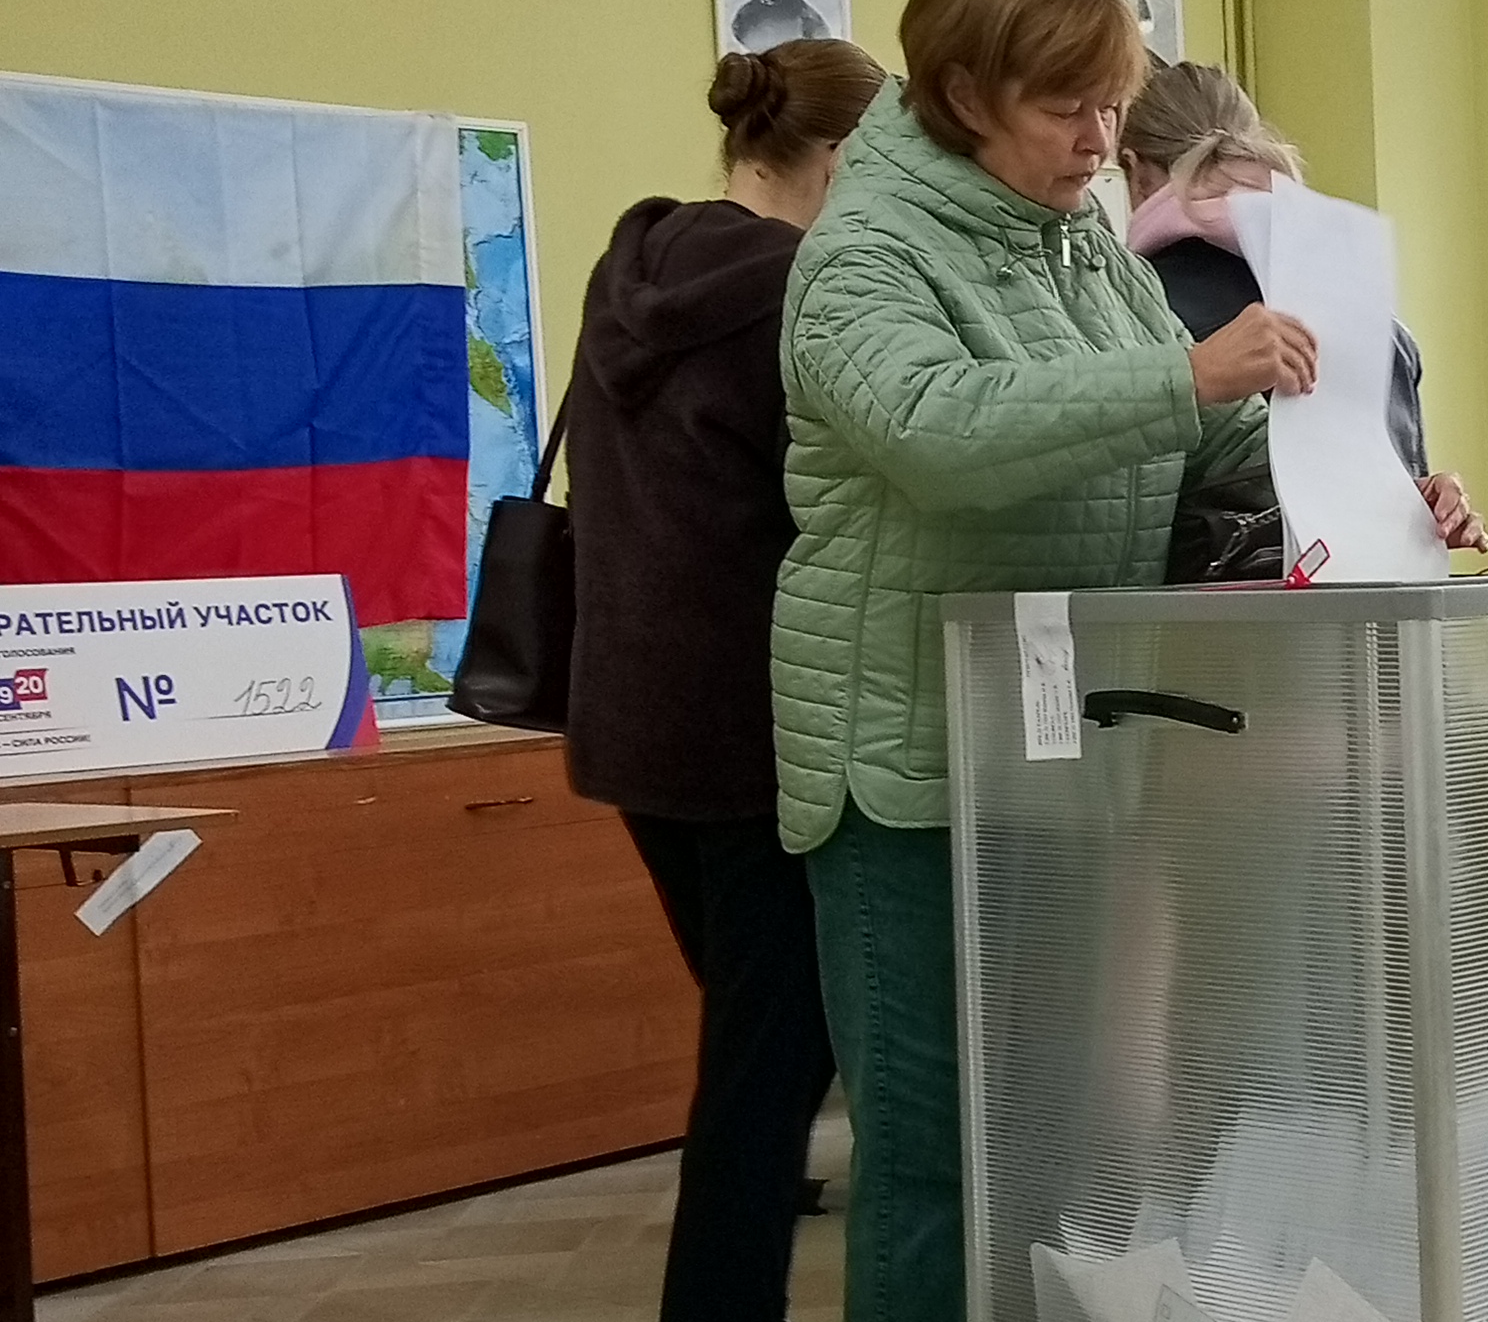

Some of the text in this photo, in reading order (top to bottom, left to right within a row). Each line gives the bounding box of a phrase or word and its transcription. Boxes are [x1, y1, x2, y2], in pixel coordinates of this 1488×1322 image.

[193, 599, 334, 628] УЧАСТОК
[15, 675, 43, 694] 20
[115, 675, 176, 721] №
